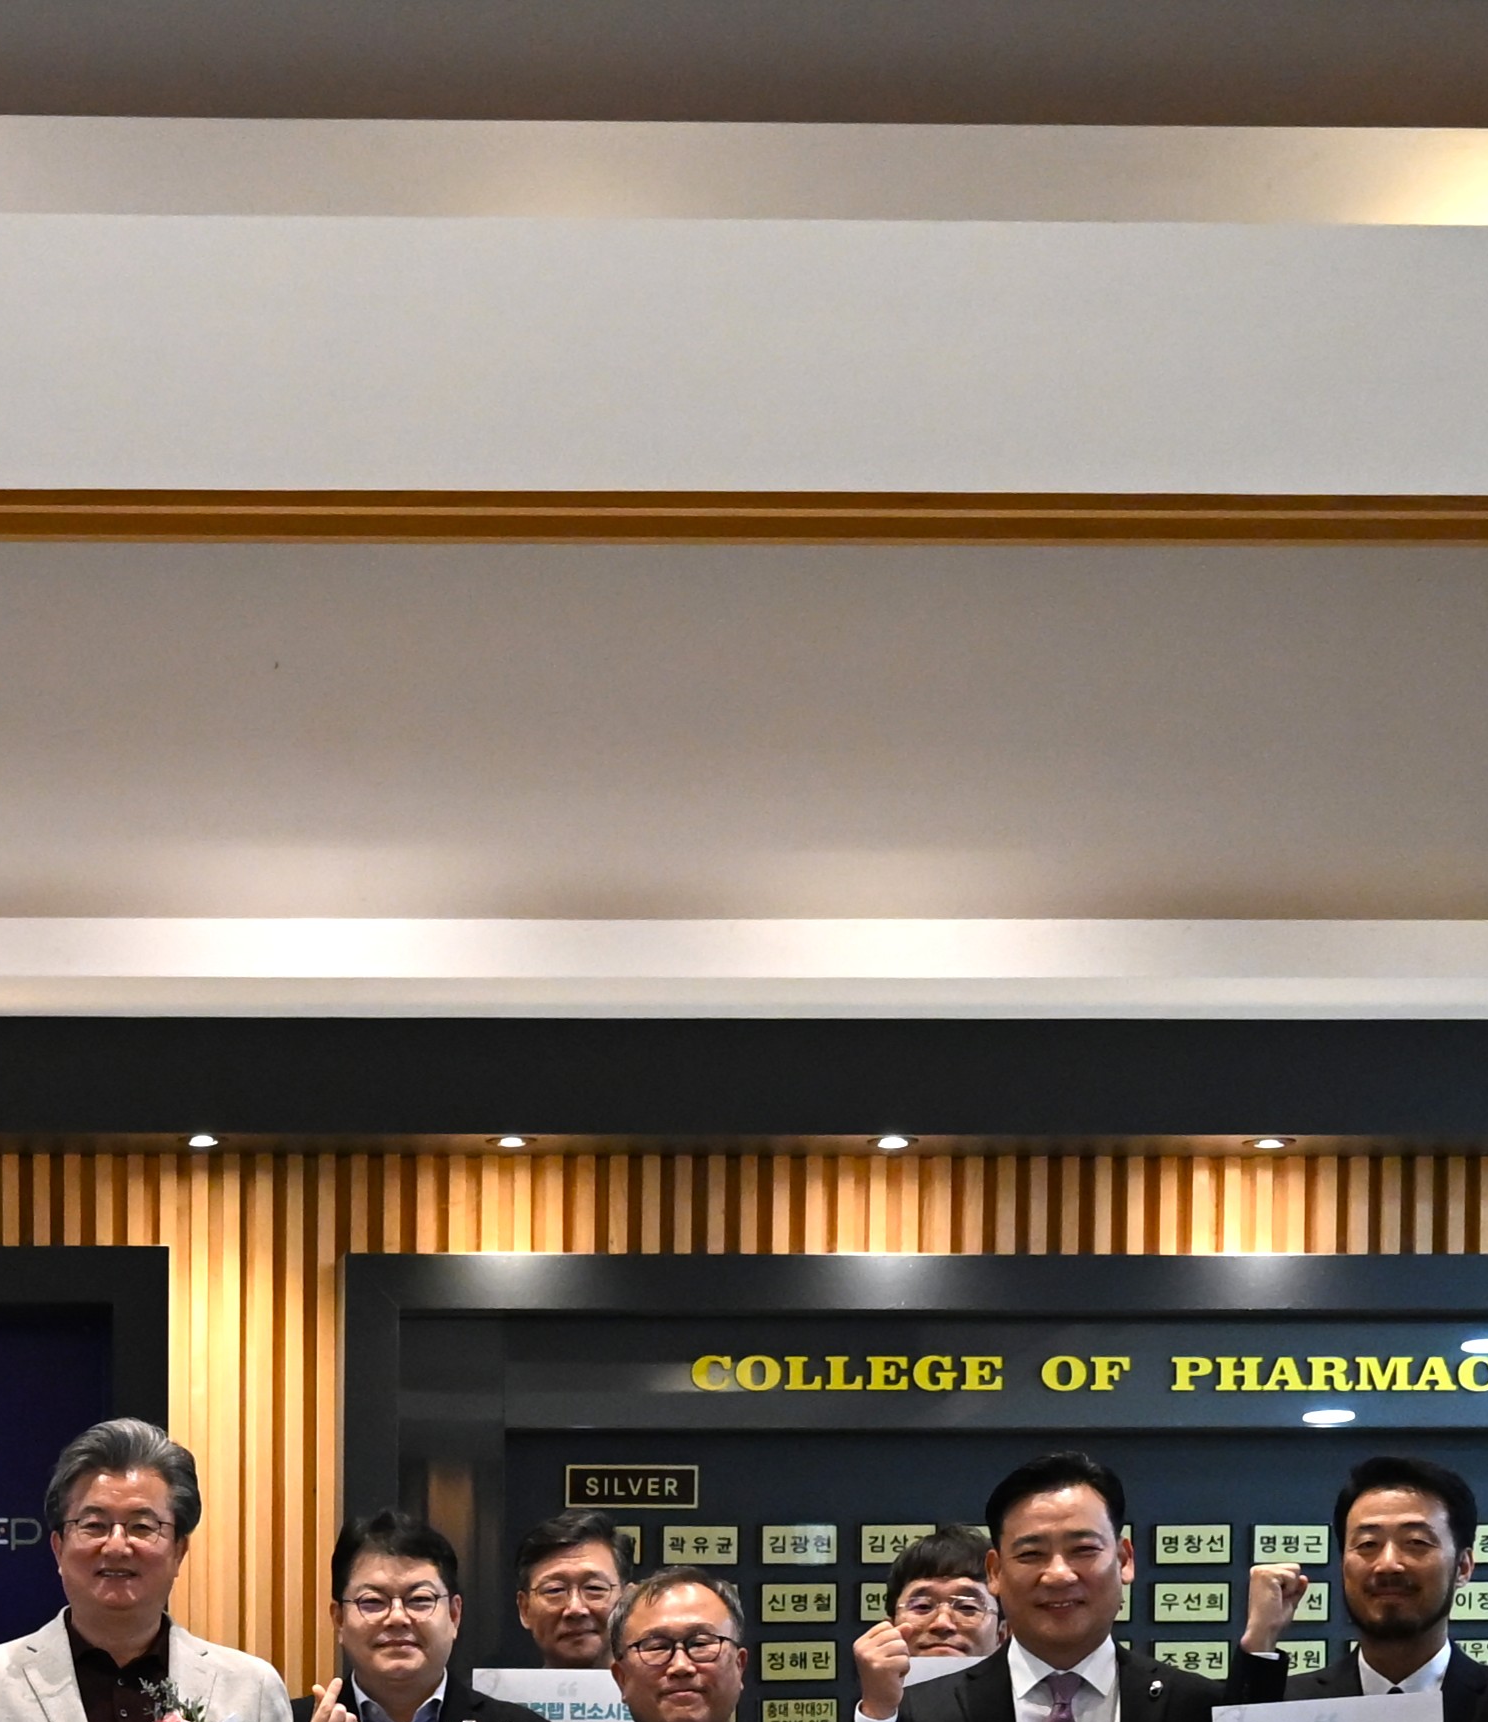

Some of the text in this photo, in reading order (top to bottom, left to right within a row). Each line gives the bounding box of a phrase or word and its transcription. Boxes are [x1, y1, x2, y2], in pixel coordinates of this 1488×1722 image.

[690, 1355, 1004, 1392] COLLEGE
[1041, 1356, 1131, 1391] OF
[586, 1478, 677, 1496] SILVER
[669, 1537, 732, 1554] 곽유균
[1162, 1535, 1223, 1553] 명창선
[1260, 1535, 1322, 1553] 명평근
[768, 1594, 830, 1612] 신명철
[1161, 1593, 1223, 1611] 우선희
[767, 1651, 830, 1670] 정해란
